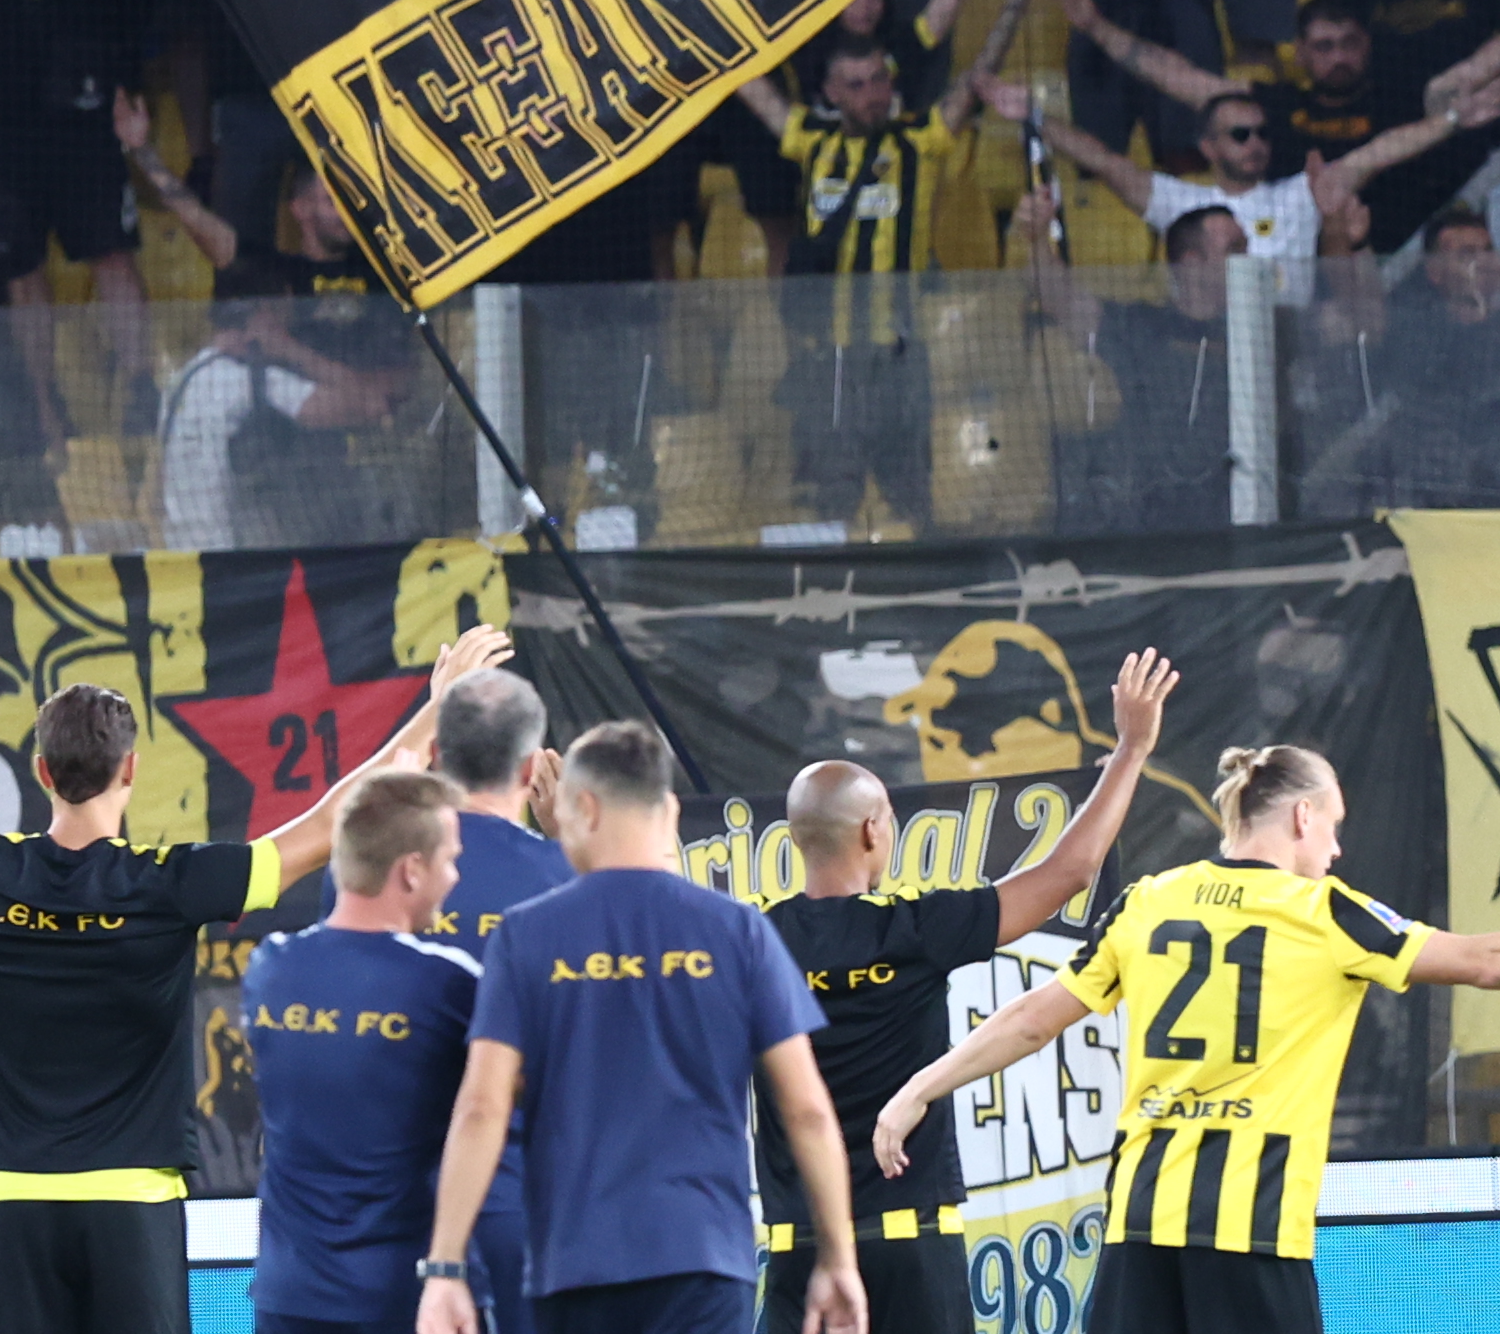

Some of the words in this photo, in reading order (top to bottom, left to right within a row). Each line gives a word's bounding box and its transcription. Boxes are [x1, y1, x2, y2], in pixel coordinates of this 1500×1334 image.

[268, 709, 340, 792] 21
[1194, 882, 1245, 910] VIDA
[662, 950, 715, 980] FC
[849, 964, 896, 990] FC
[1144, 919, 1268, 1064] 21
[356, 1011, 411, 1041] FC
[1137, 1098, 1253, 1119] SEAJETS
